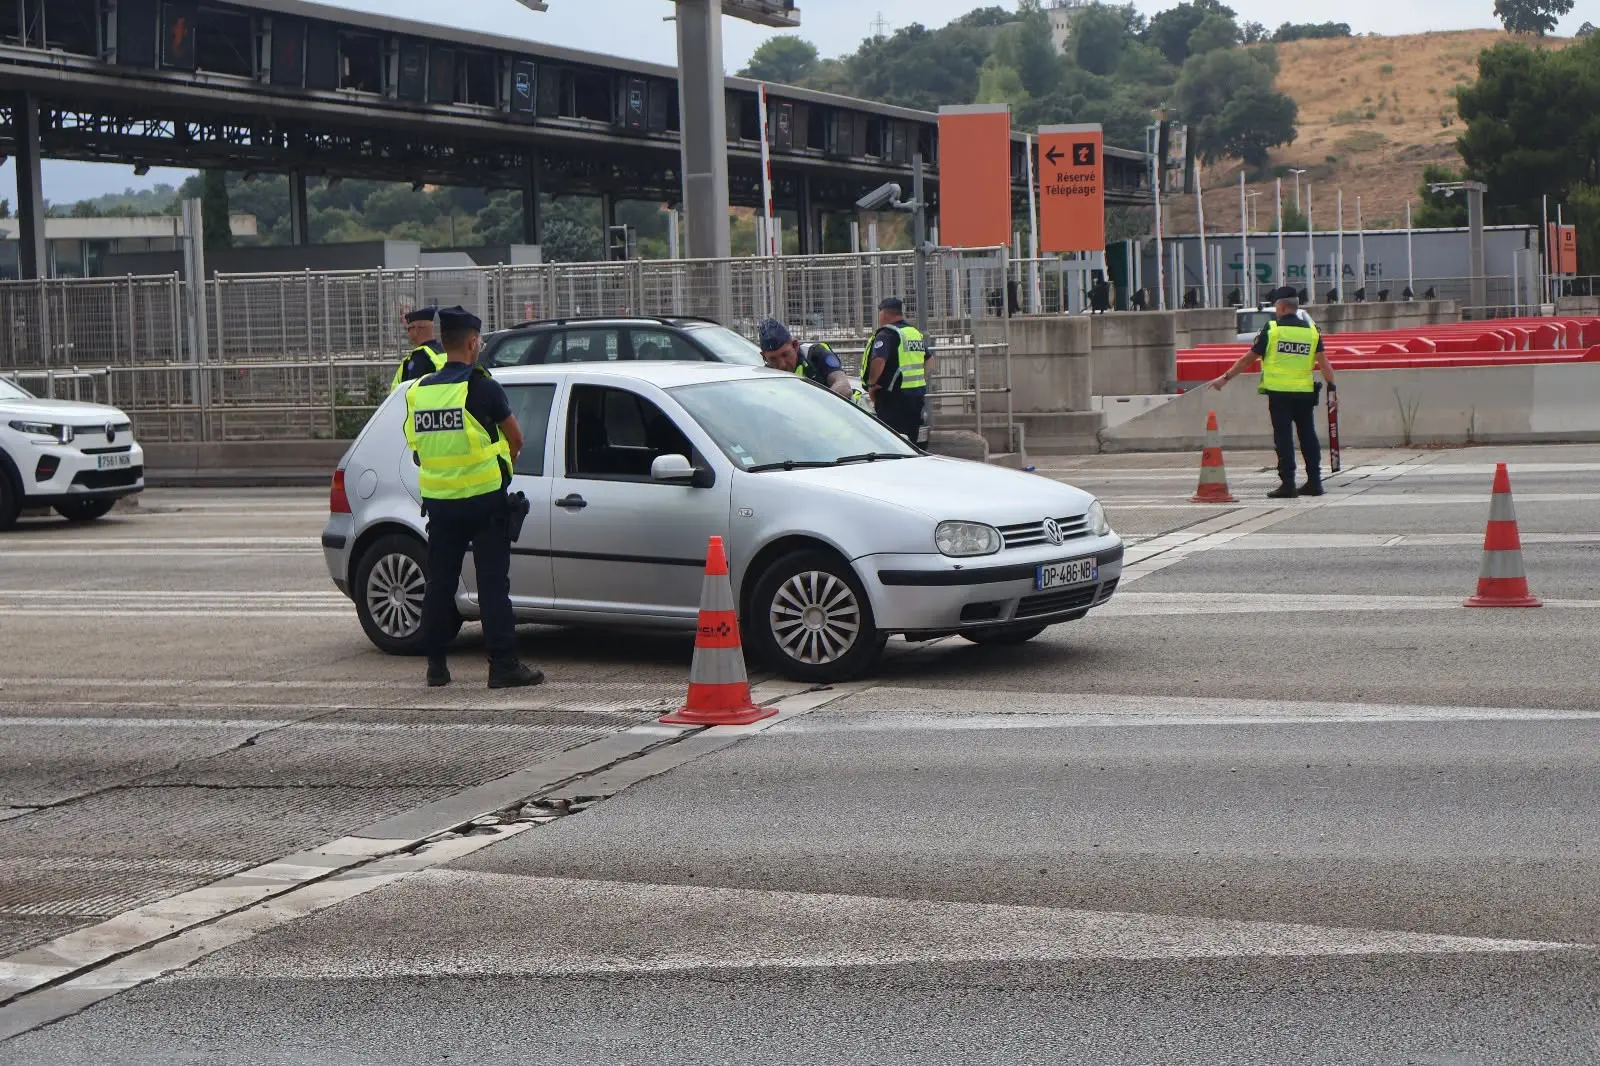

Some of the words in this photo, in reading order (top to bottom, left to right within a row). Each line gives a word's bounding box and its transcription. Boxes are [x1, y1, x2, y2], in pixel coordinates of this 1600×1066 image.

[1057, 171, 1096, 182] Réservé
[1045, 184, 1096, 197] Télépéage
[1278, 342, 1311, 354] POLICE
[415, 411, 463, 430] POLICE
[1042, 561, 1091, 587] DP-486-NB
